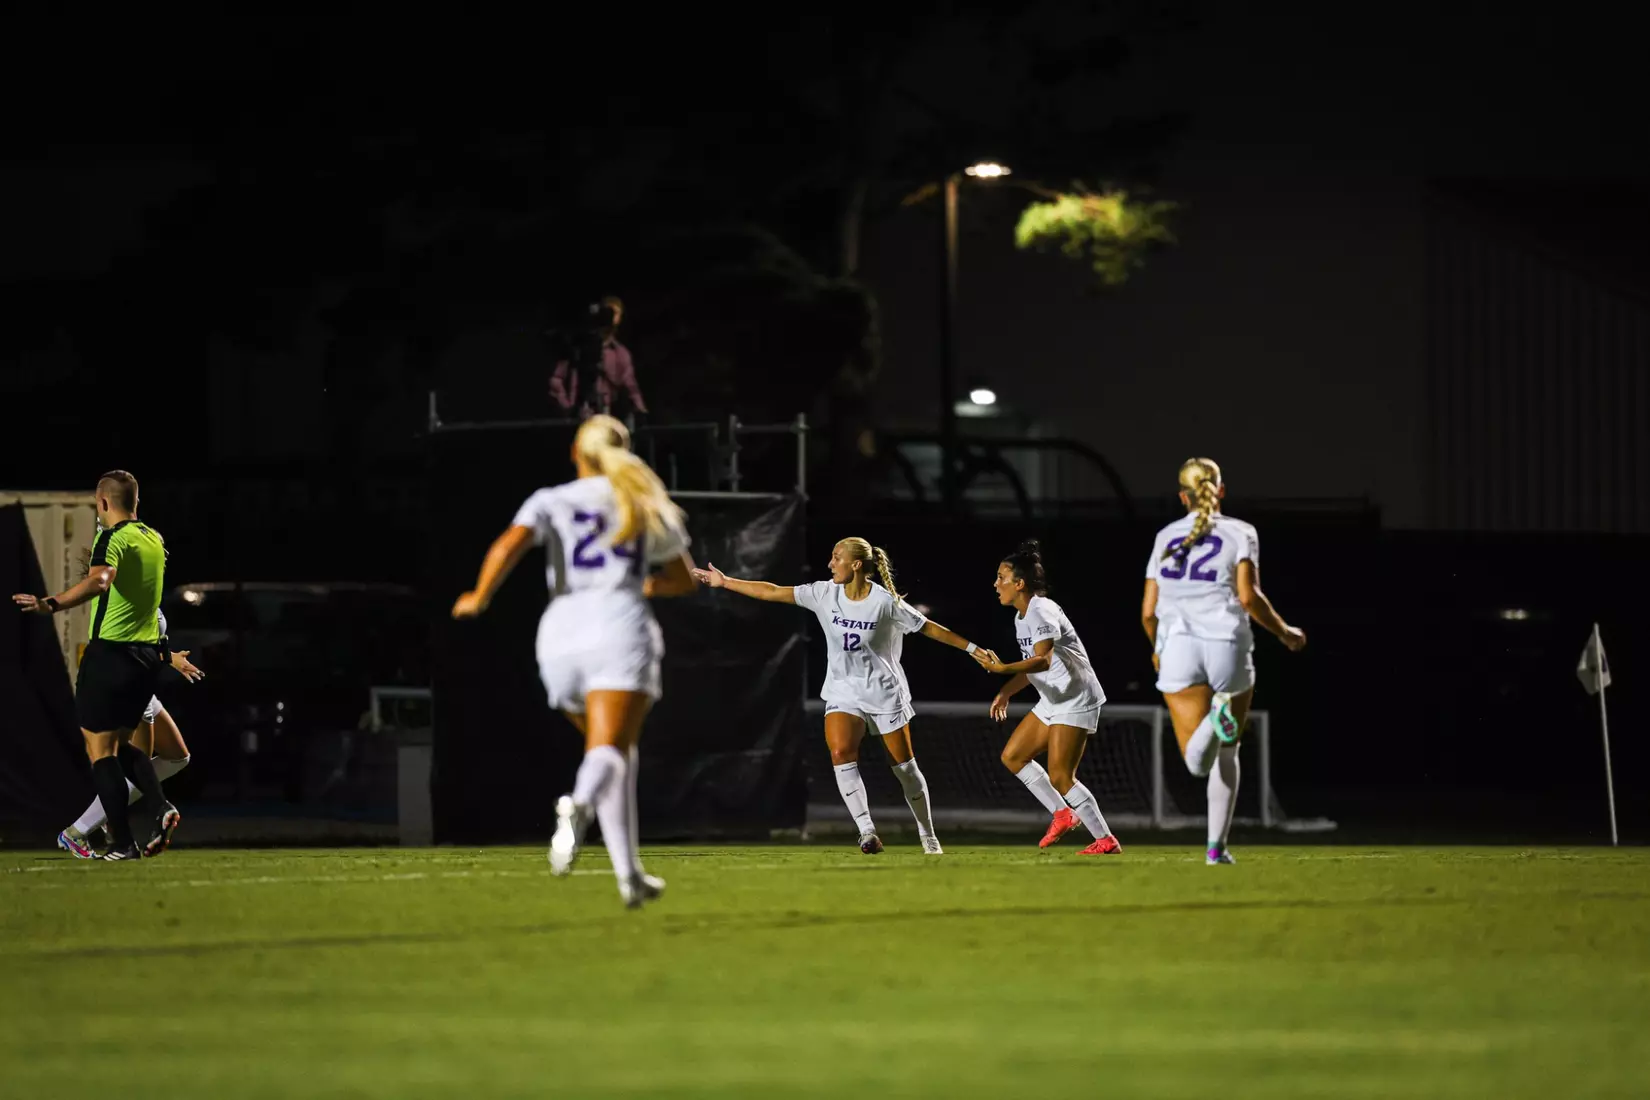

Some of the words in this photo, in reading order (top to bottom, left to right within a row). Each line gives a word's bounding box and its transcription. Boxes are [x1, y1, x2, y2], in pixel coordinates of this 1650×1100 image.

[573, 510, 643, 576] 24
[1159, 535, 1223, 581] 32
[833, 616, 878, 630] K-STATE
[843, 632, 861, 651] 12
